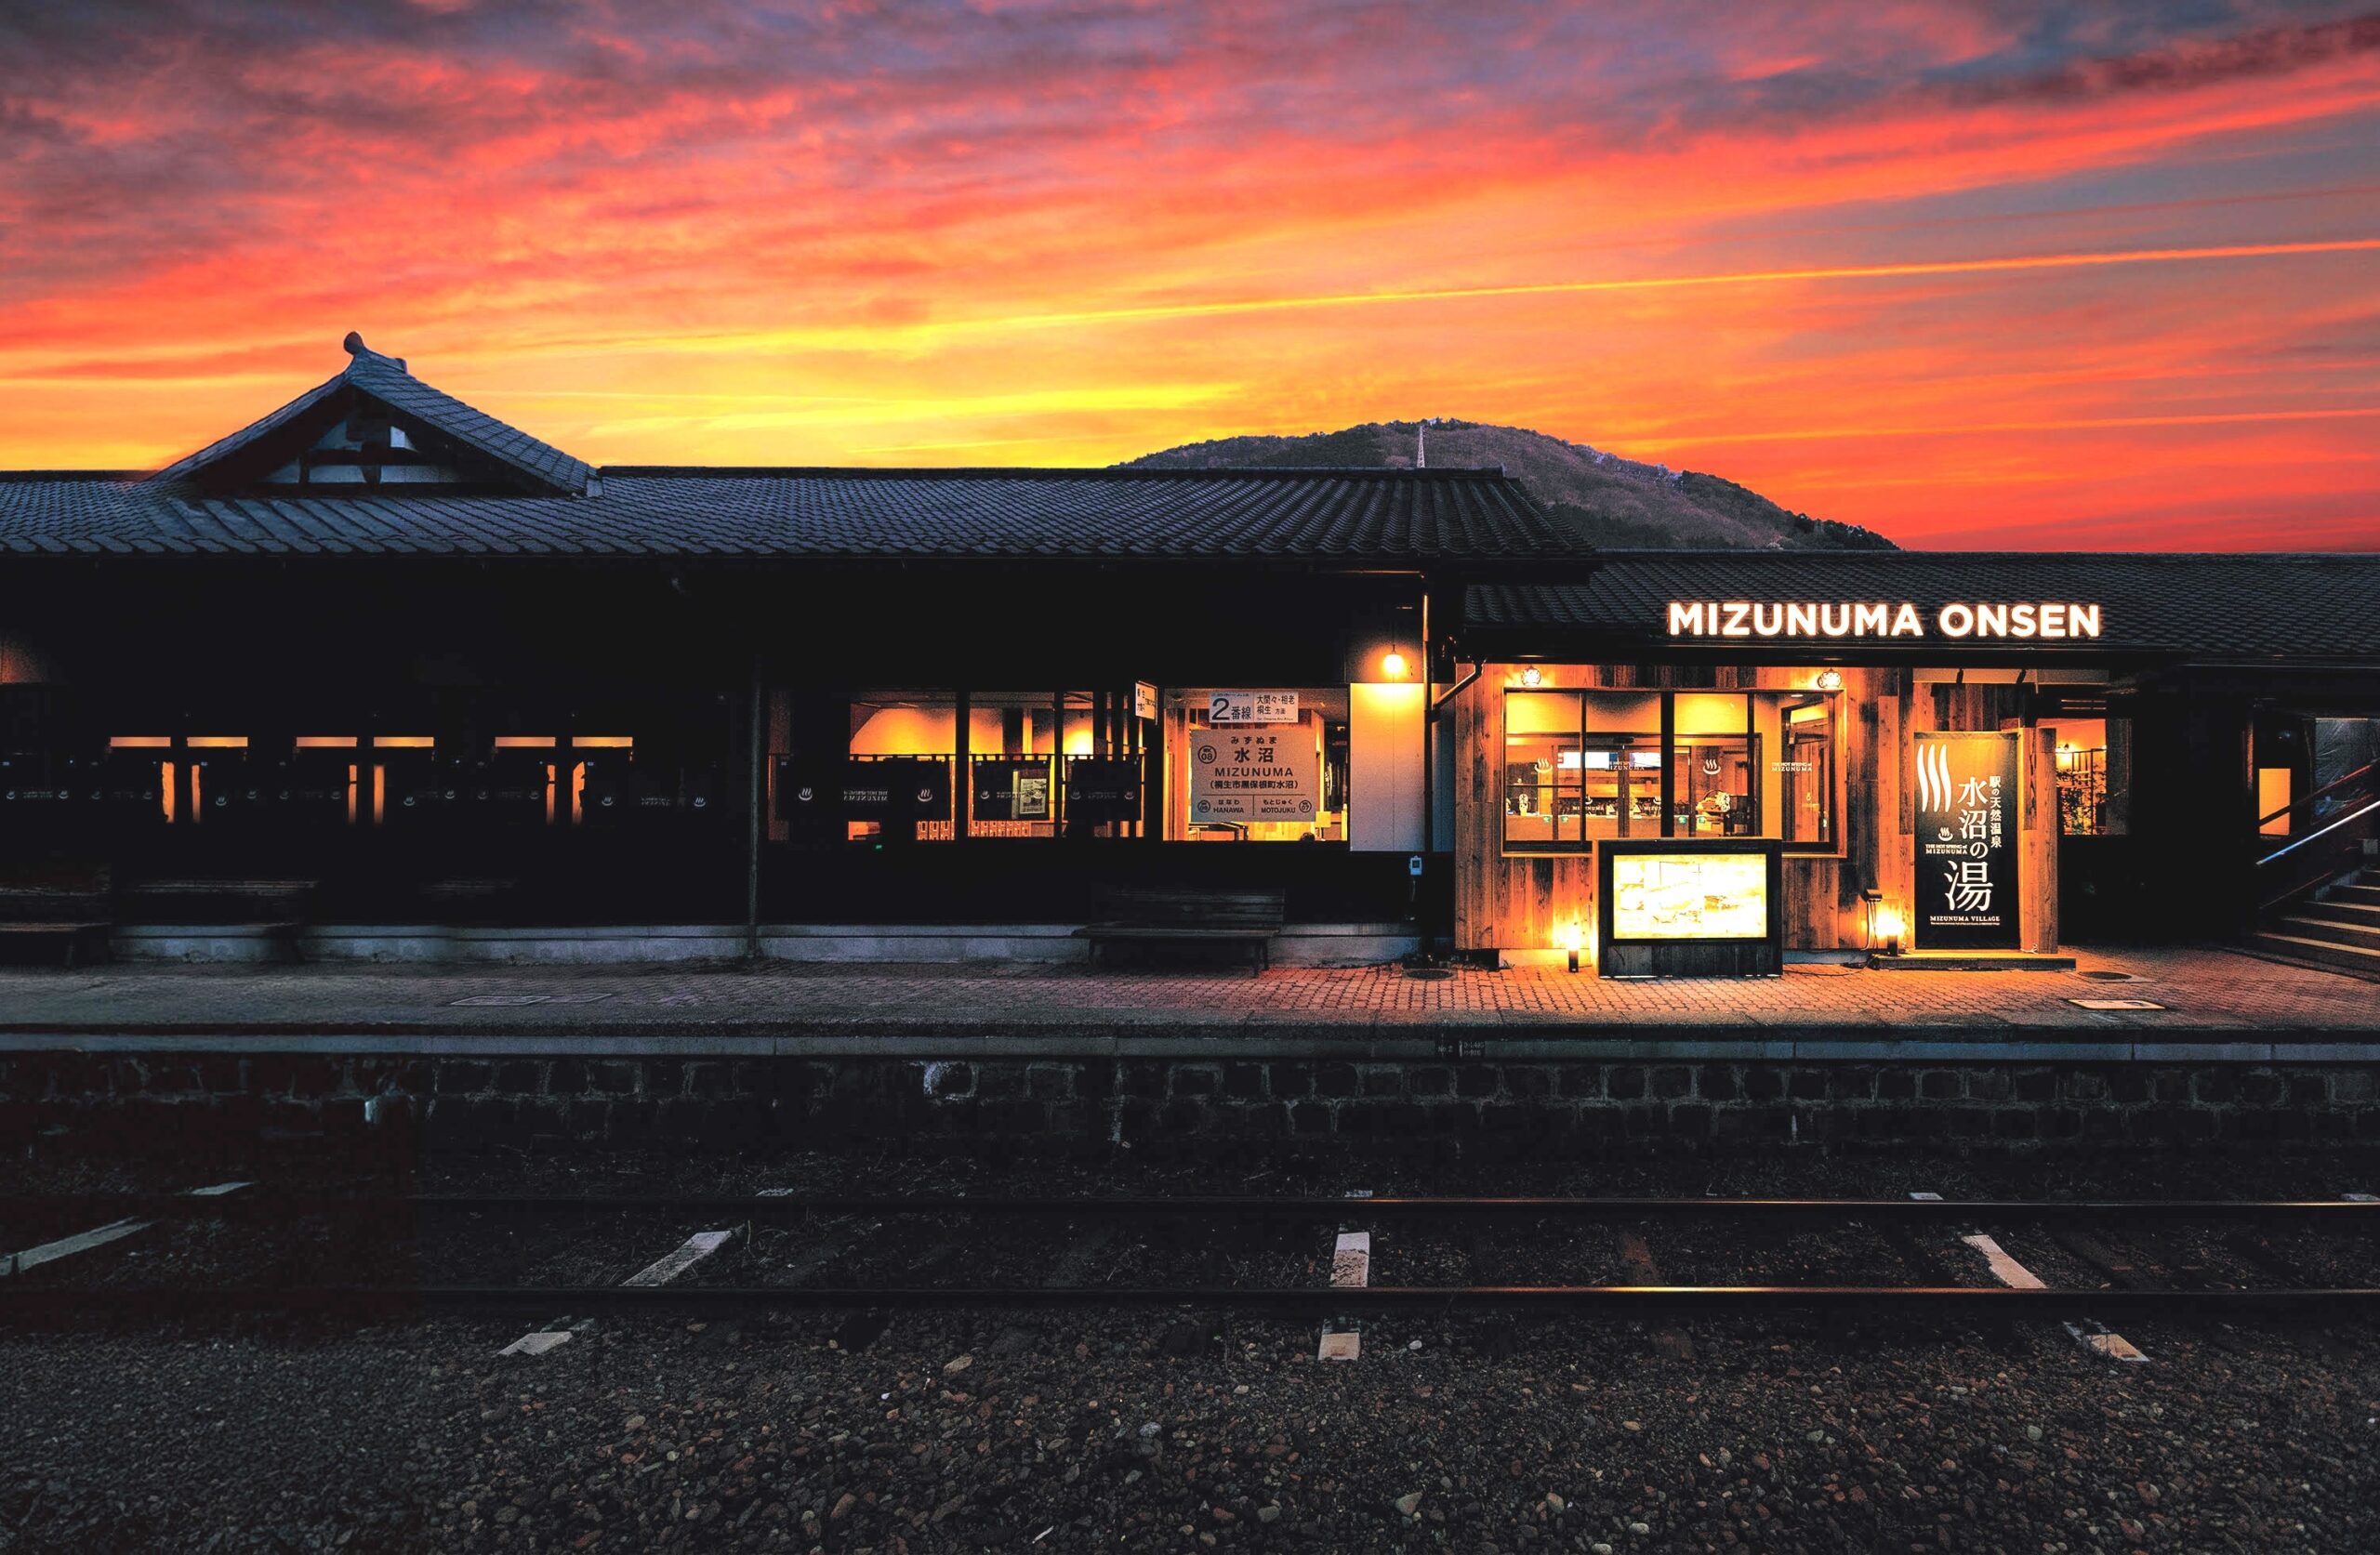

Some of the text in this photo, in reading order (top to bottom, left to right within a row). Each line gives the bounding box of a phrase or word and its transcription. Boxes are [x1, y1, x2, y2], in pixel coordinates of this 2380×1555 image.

[1670, 602, 2099, 638] MIZUNUMA ONSEN
[1211, 697, 1251, 720] 2番線
[1257, 705, 1271, 715] 桐生
[1234, 747, 1275, 763] 水沼
[1214, 768, 1294, 777] MIZUNUMA
[1990, 775, 2003, 849] 駅の天然温泉
[1943, 776, 1994, 912] 水沼の湯
